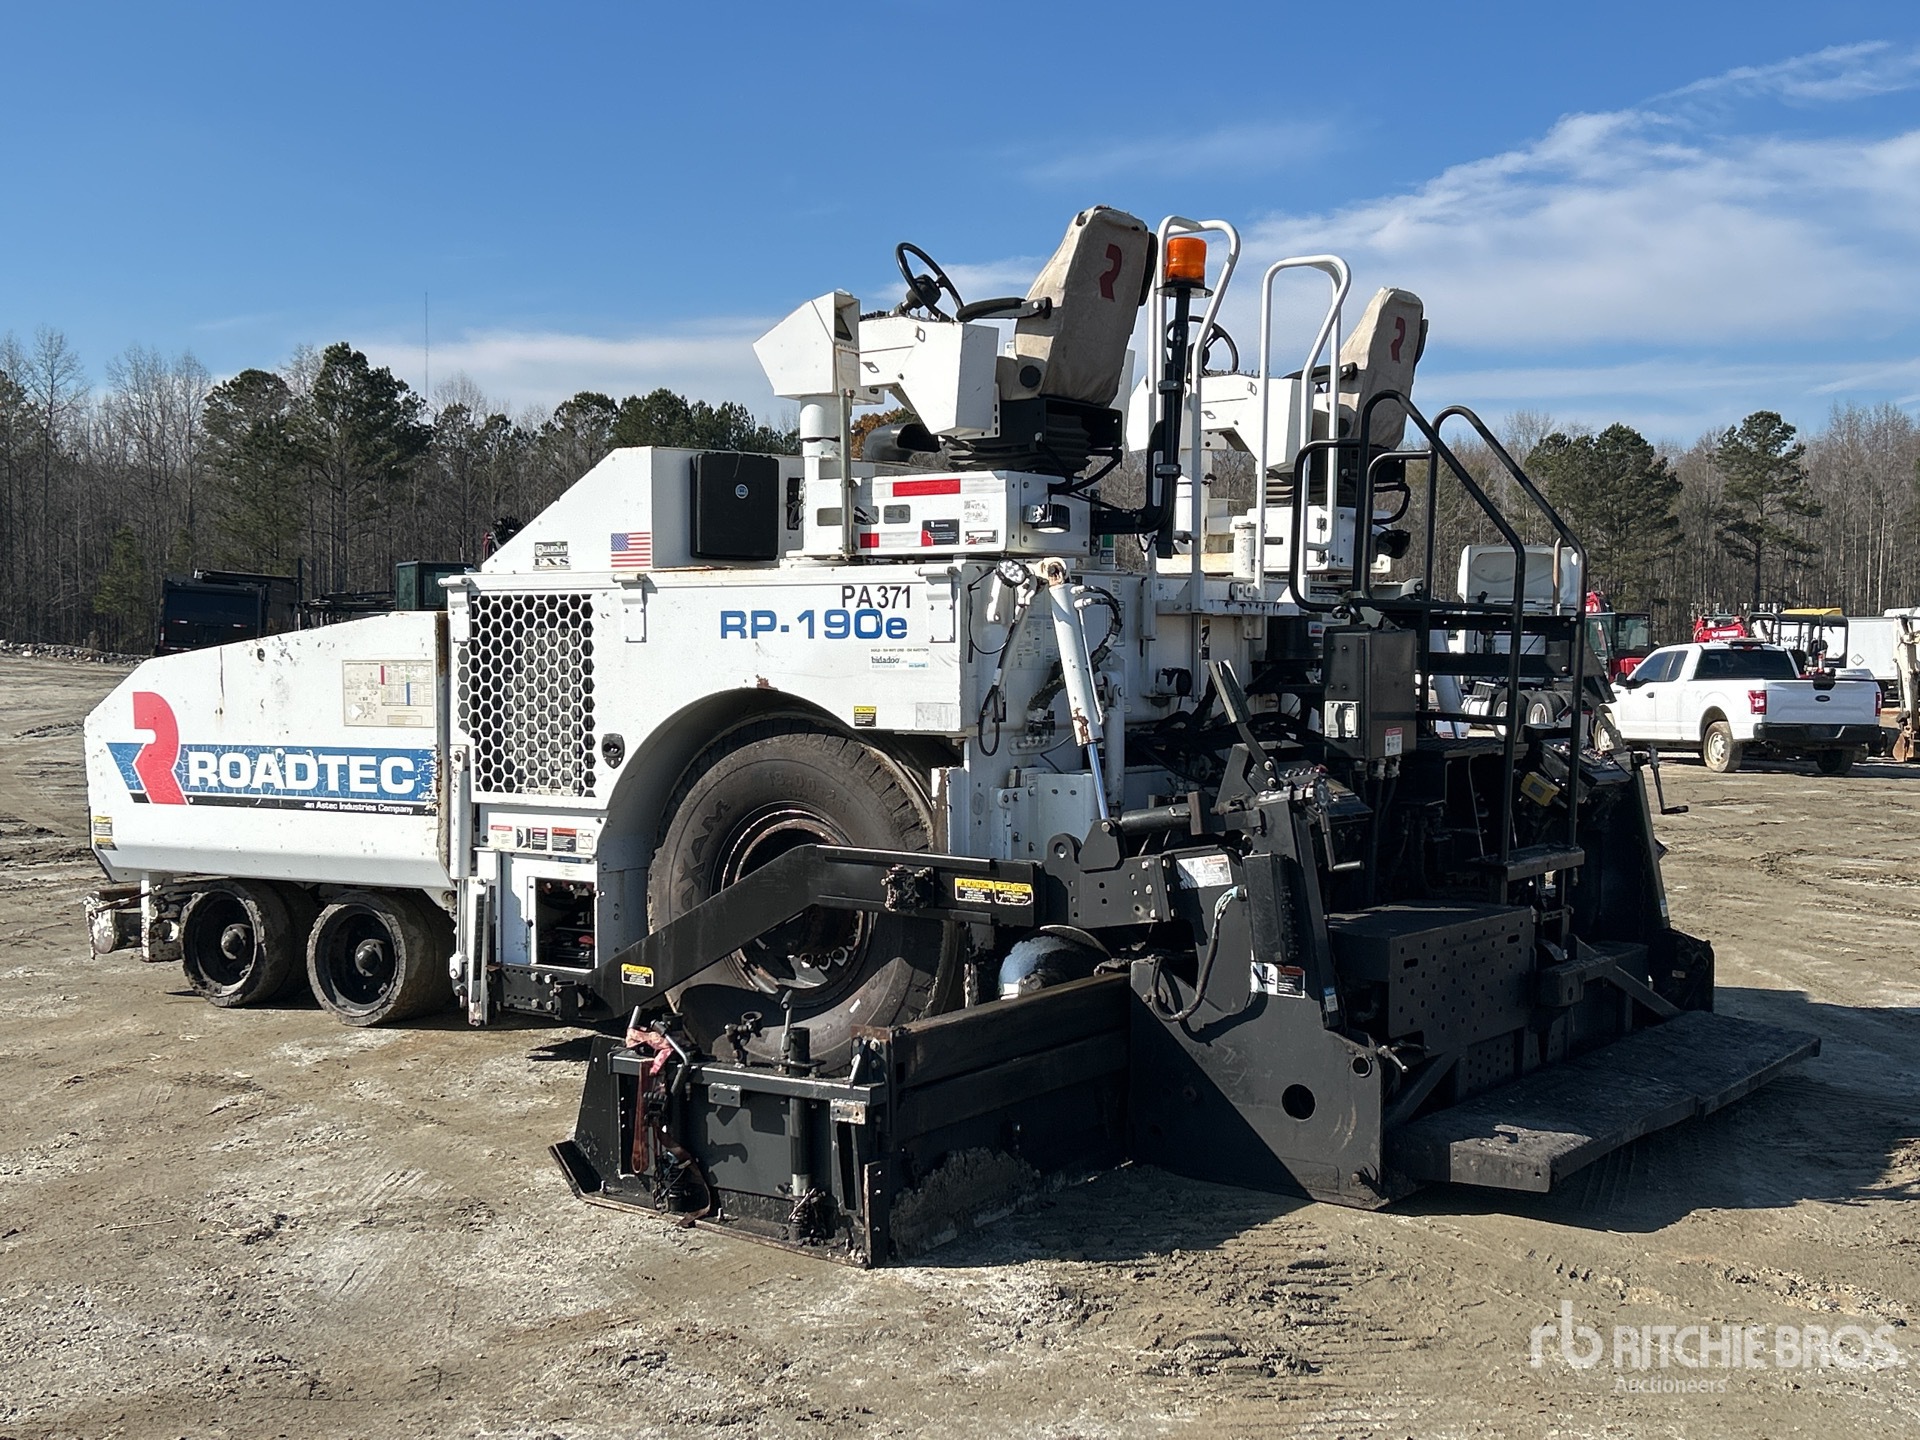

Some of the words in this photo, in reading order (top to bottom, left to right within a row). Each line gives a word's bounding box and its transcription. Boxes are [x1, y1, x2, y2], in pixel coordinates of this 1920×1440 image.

[842, 585, 911, 609] PA371
[720, 609, 908, 640] RP-190e
[188, 751, 415, 795] ROADTEC
[316, 801, 338, 810] Astec
[339, 802, 377, 812] Industries
[378, 804, 413, 815] Company
